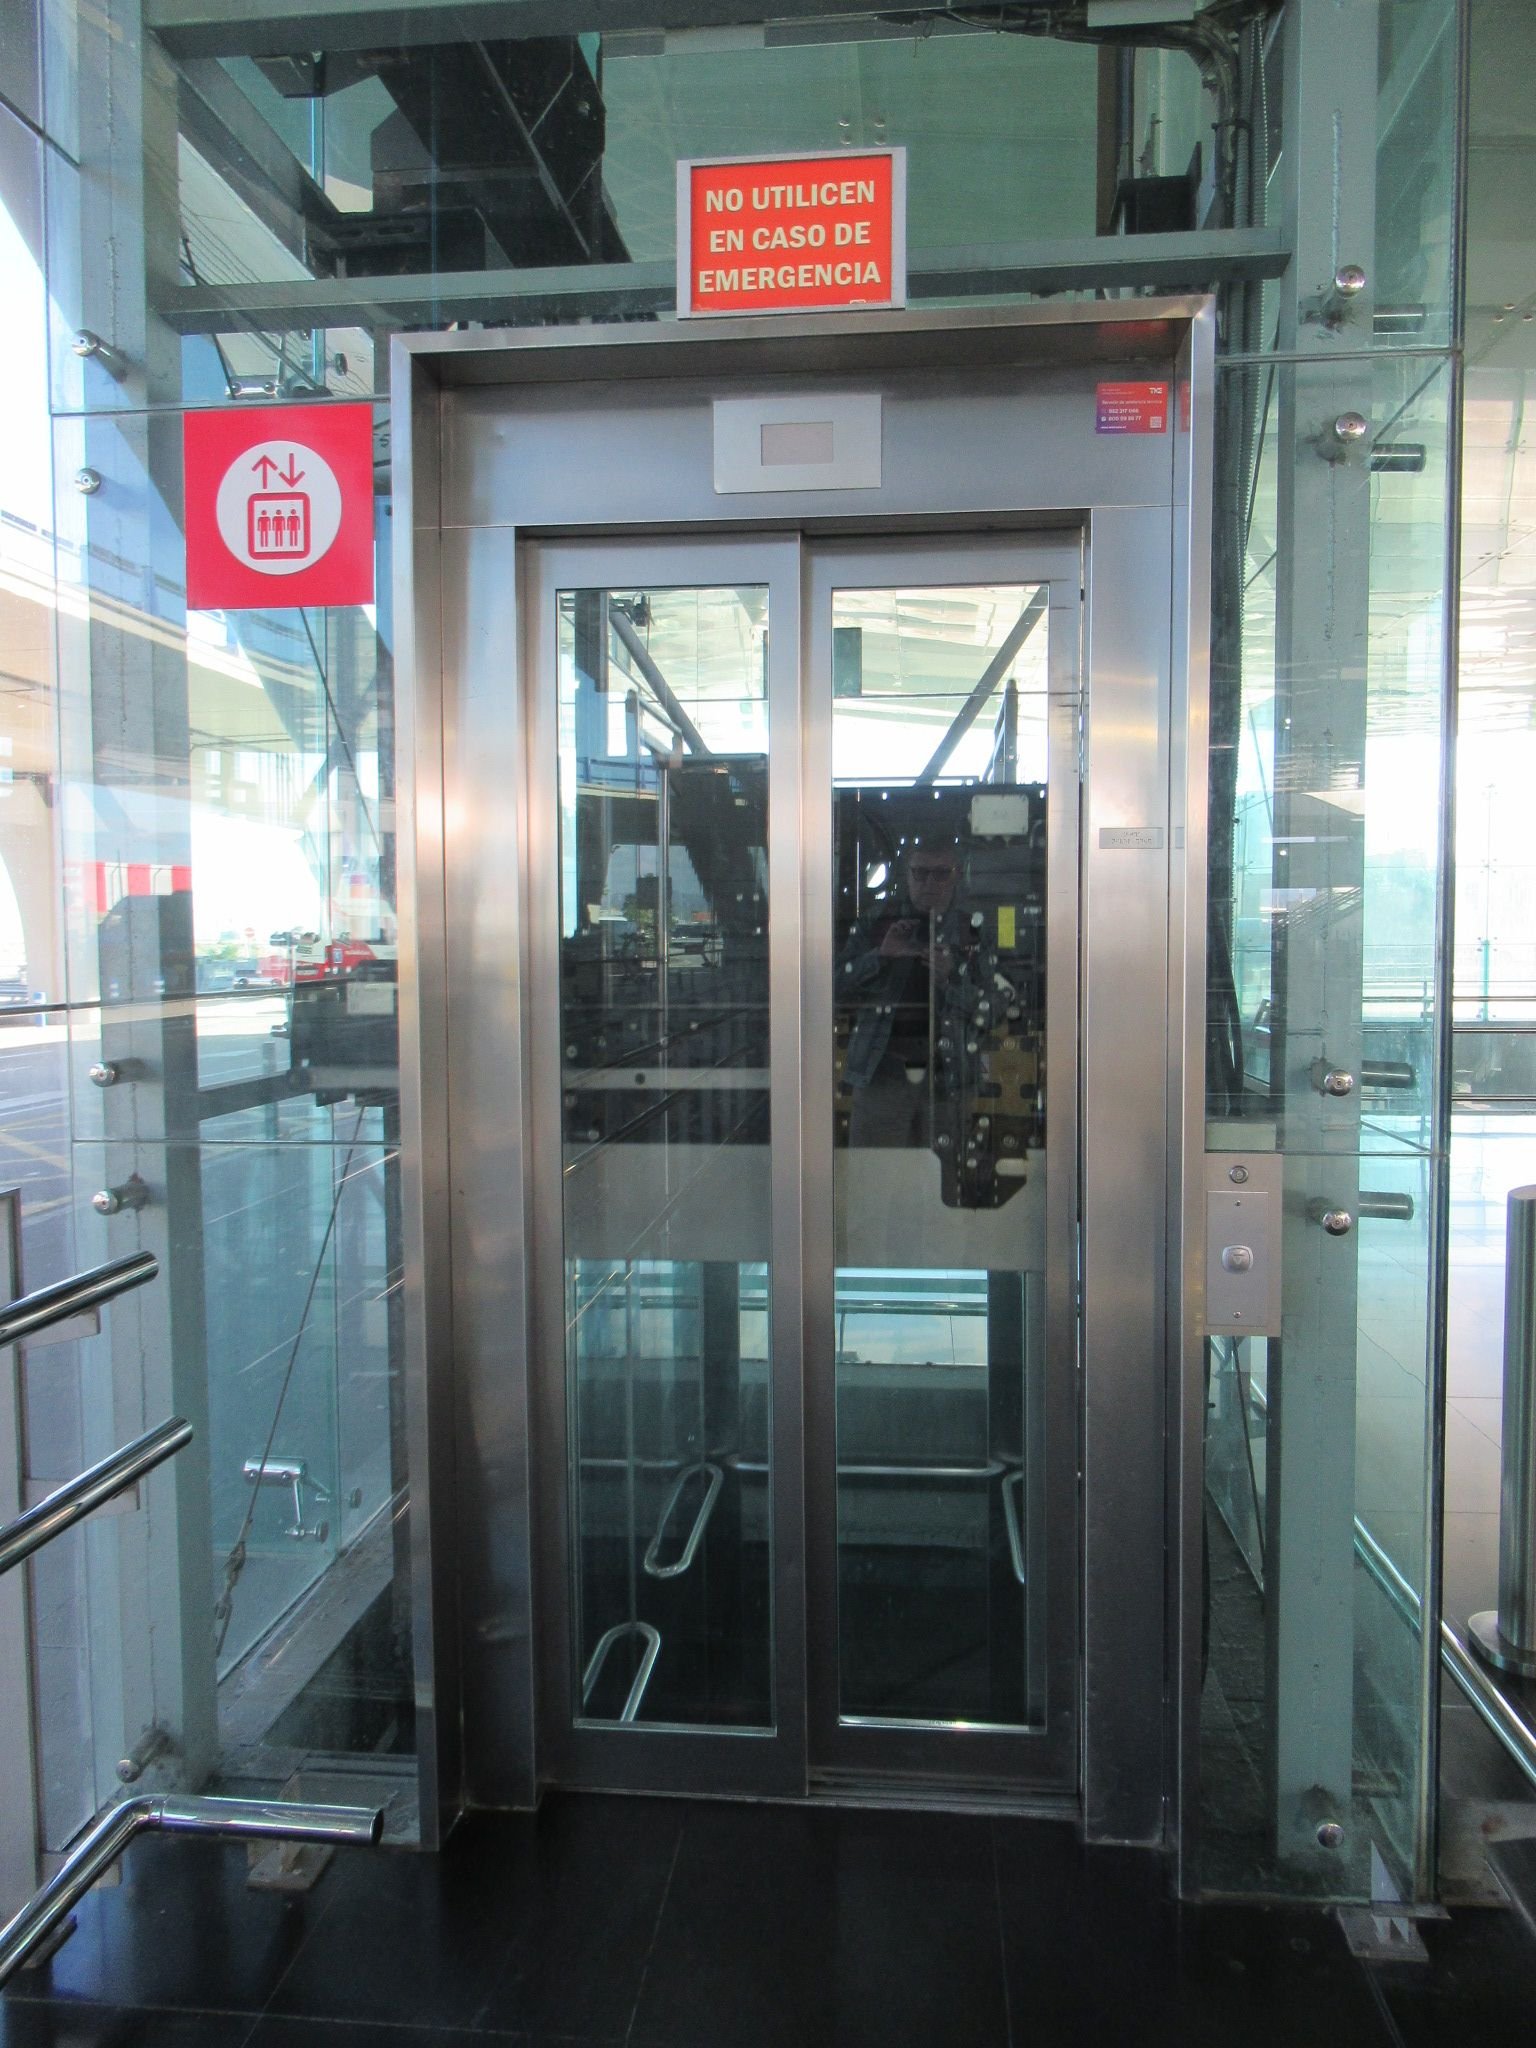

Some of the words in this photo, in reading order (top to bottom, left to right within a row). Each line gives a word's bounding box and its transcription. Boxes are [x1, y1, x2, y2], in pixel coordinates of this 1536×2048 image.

[706, 188, 744, 213] NO
[752, 180, 875, 210] UTILICEN
[709, 229, 744, 253] EN
[752, 224, 825, 250] CASO
[834, 221, 871, 246] DE
[699, 261, 881, 293] EMERGENCIA
